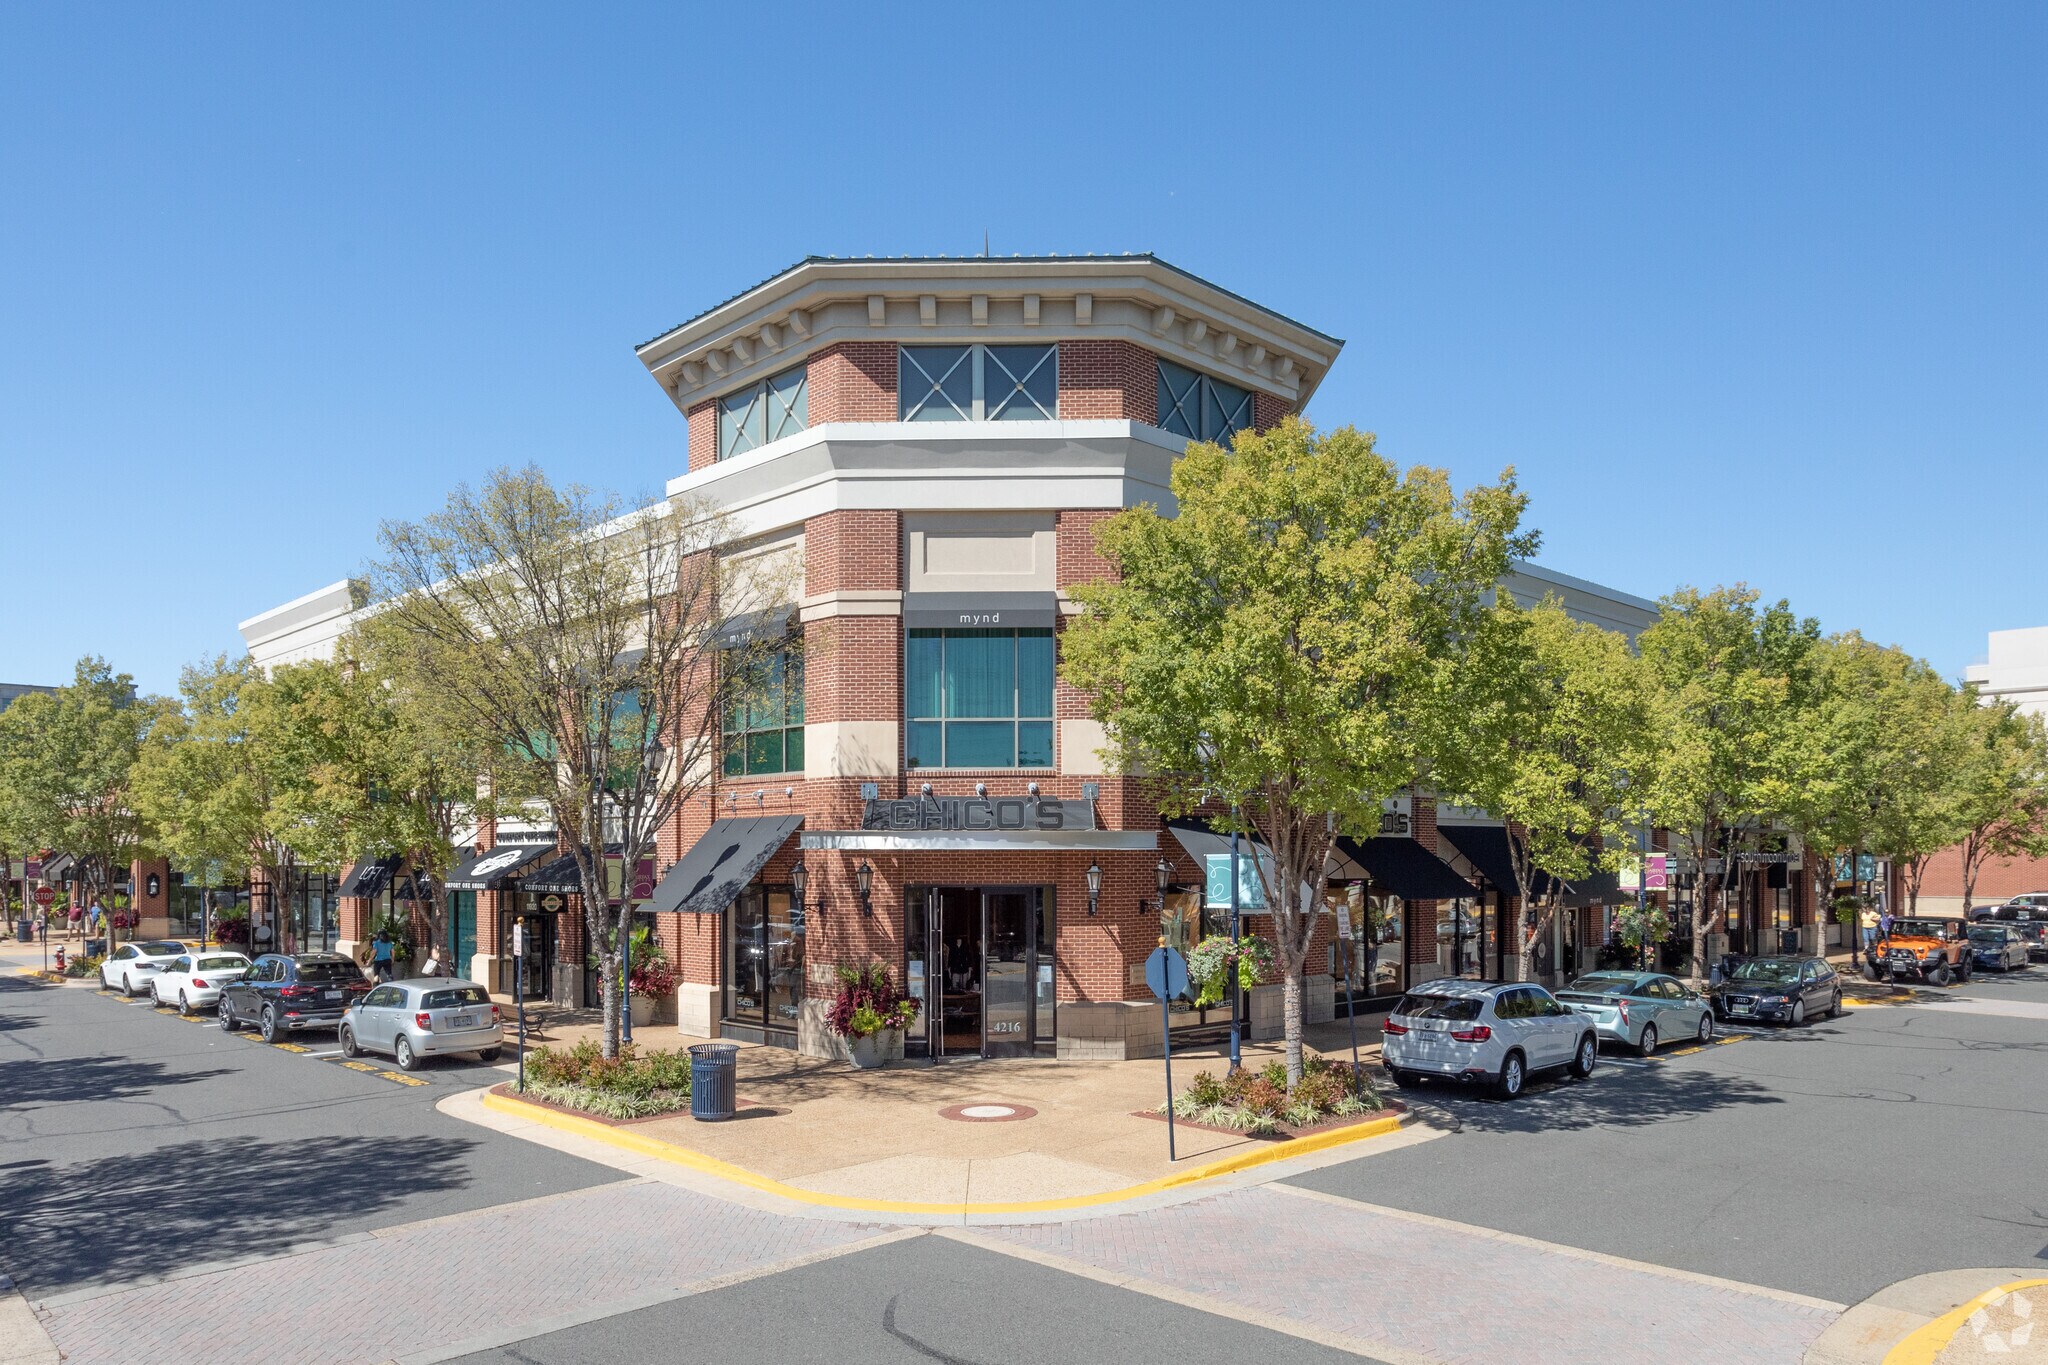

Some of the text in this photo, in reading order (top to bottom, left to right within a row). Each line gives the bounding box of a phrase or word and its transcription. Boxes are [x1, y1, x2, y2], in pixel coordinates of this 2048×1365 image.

[960, 612, 999, 625] mynd
[889, 797, 1064, 830] CHICO'S
[359, 866, 385, 880] LOFT
[525, 884, 579, 893] COMFORT ONE SHOES
[35, 892, 55, 900] STOP
[994, 1021, 1021, 1032] 4216
